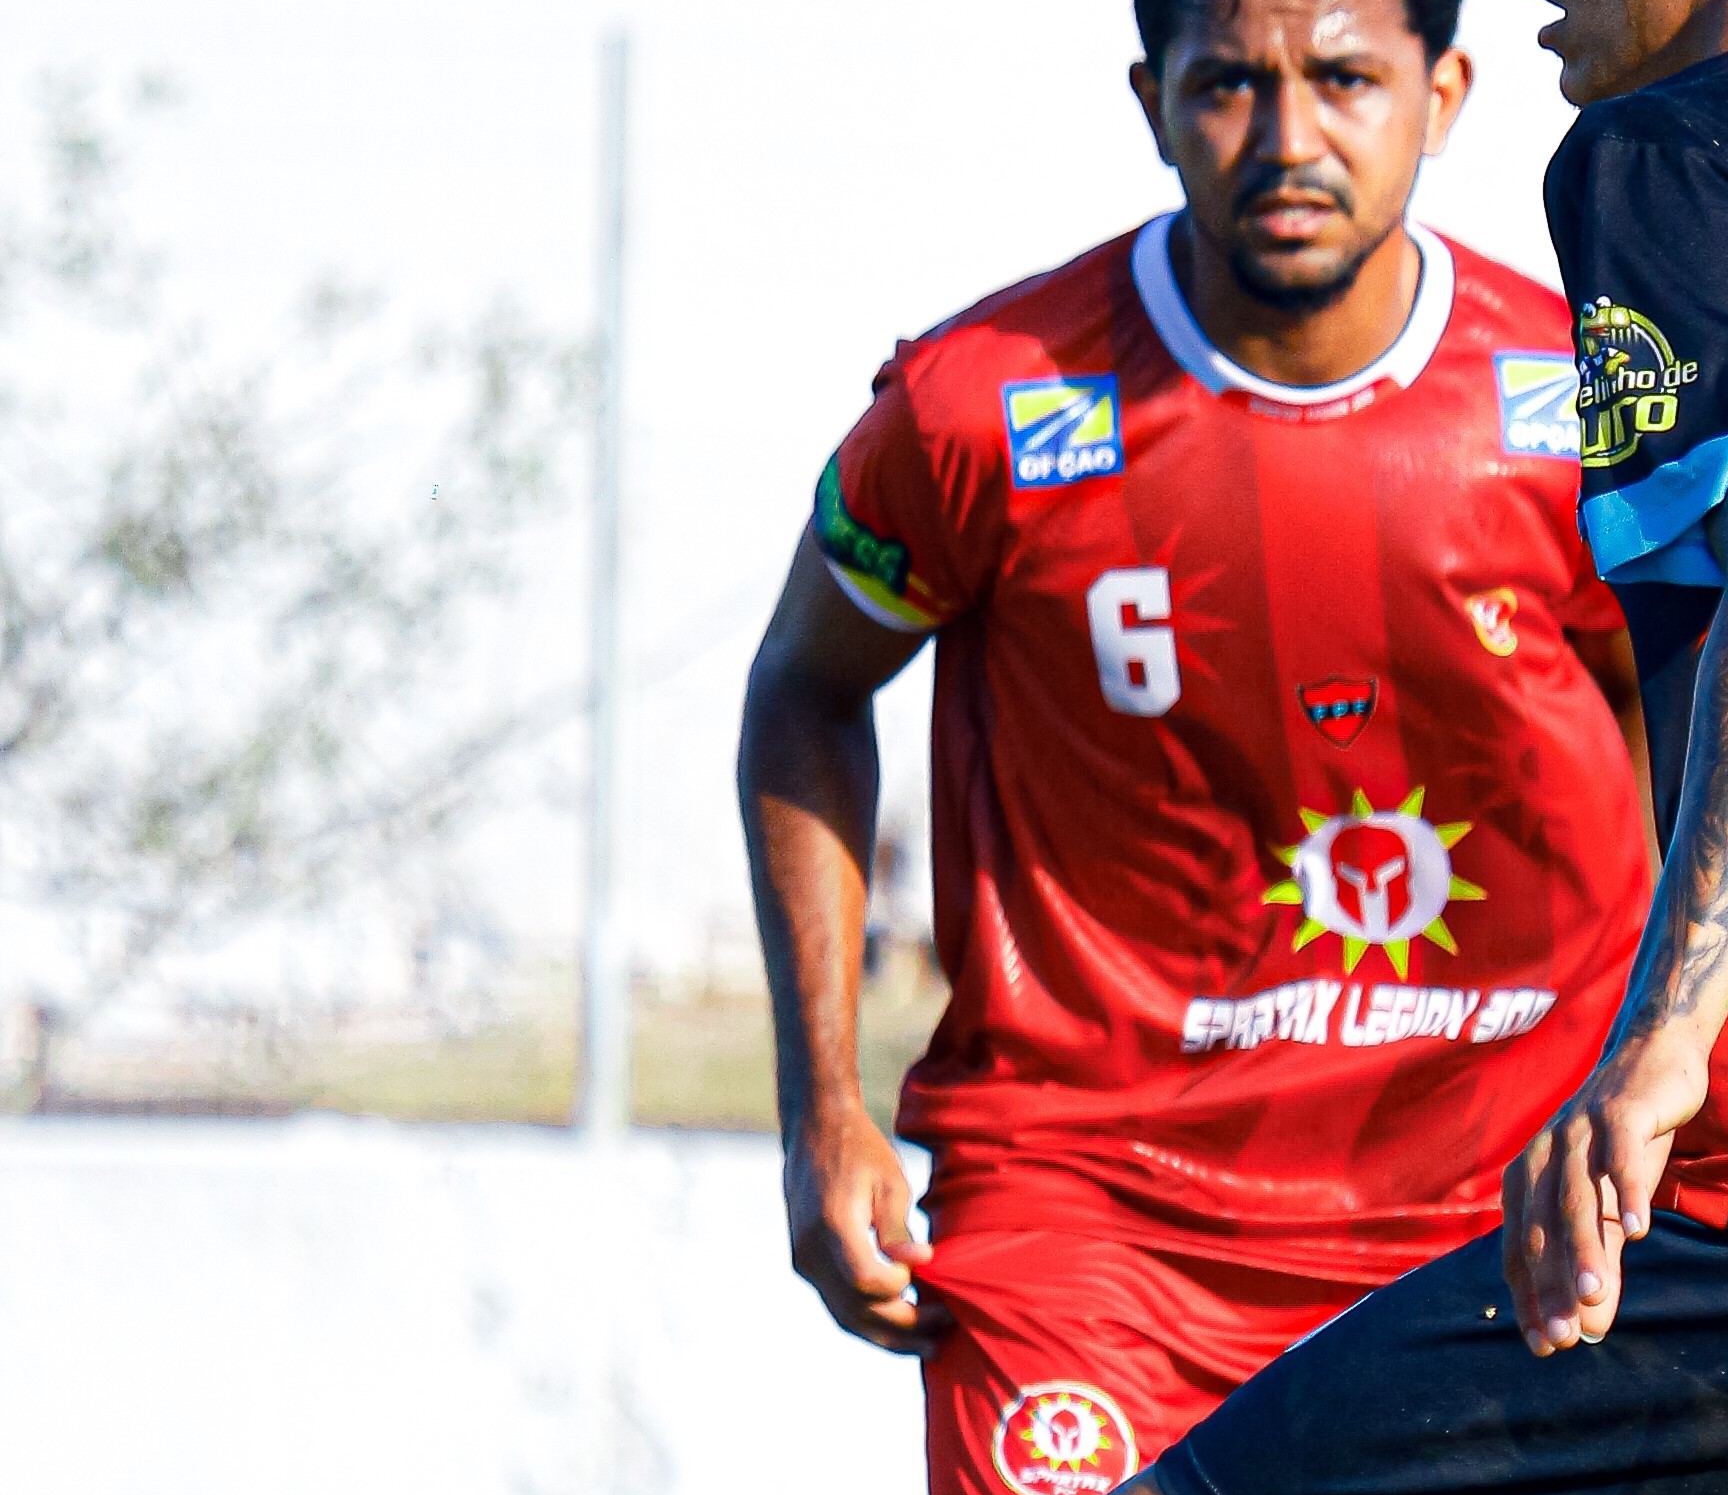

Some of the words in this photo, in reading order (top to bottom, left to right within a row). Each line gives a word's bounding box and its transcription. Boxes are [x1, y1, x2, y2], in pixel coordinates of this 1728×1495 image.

[1663, 359, 1699, 388] de
[1086, 565, 1183, 718] 6
[1341, 984, 1482, 1047] LEGION
